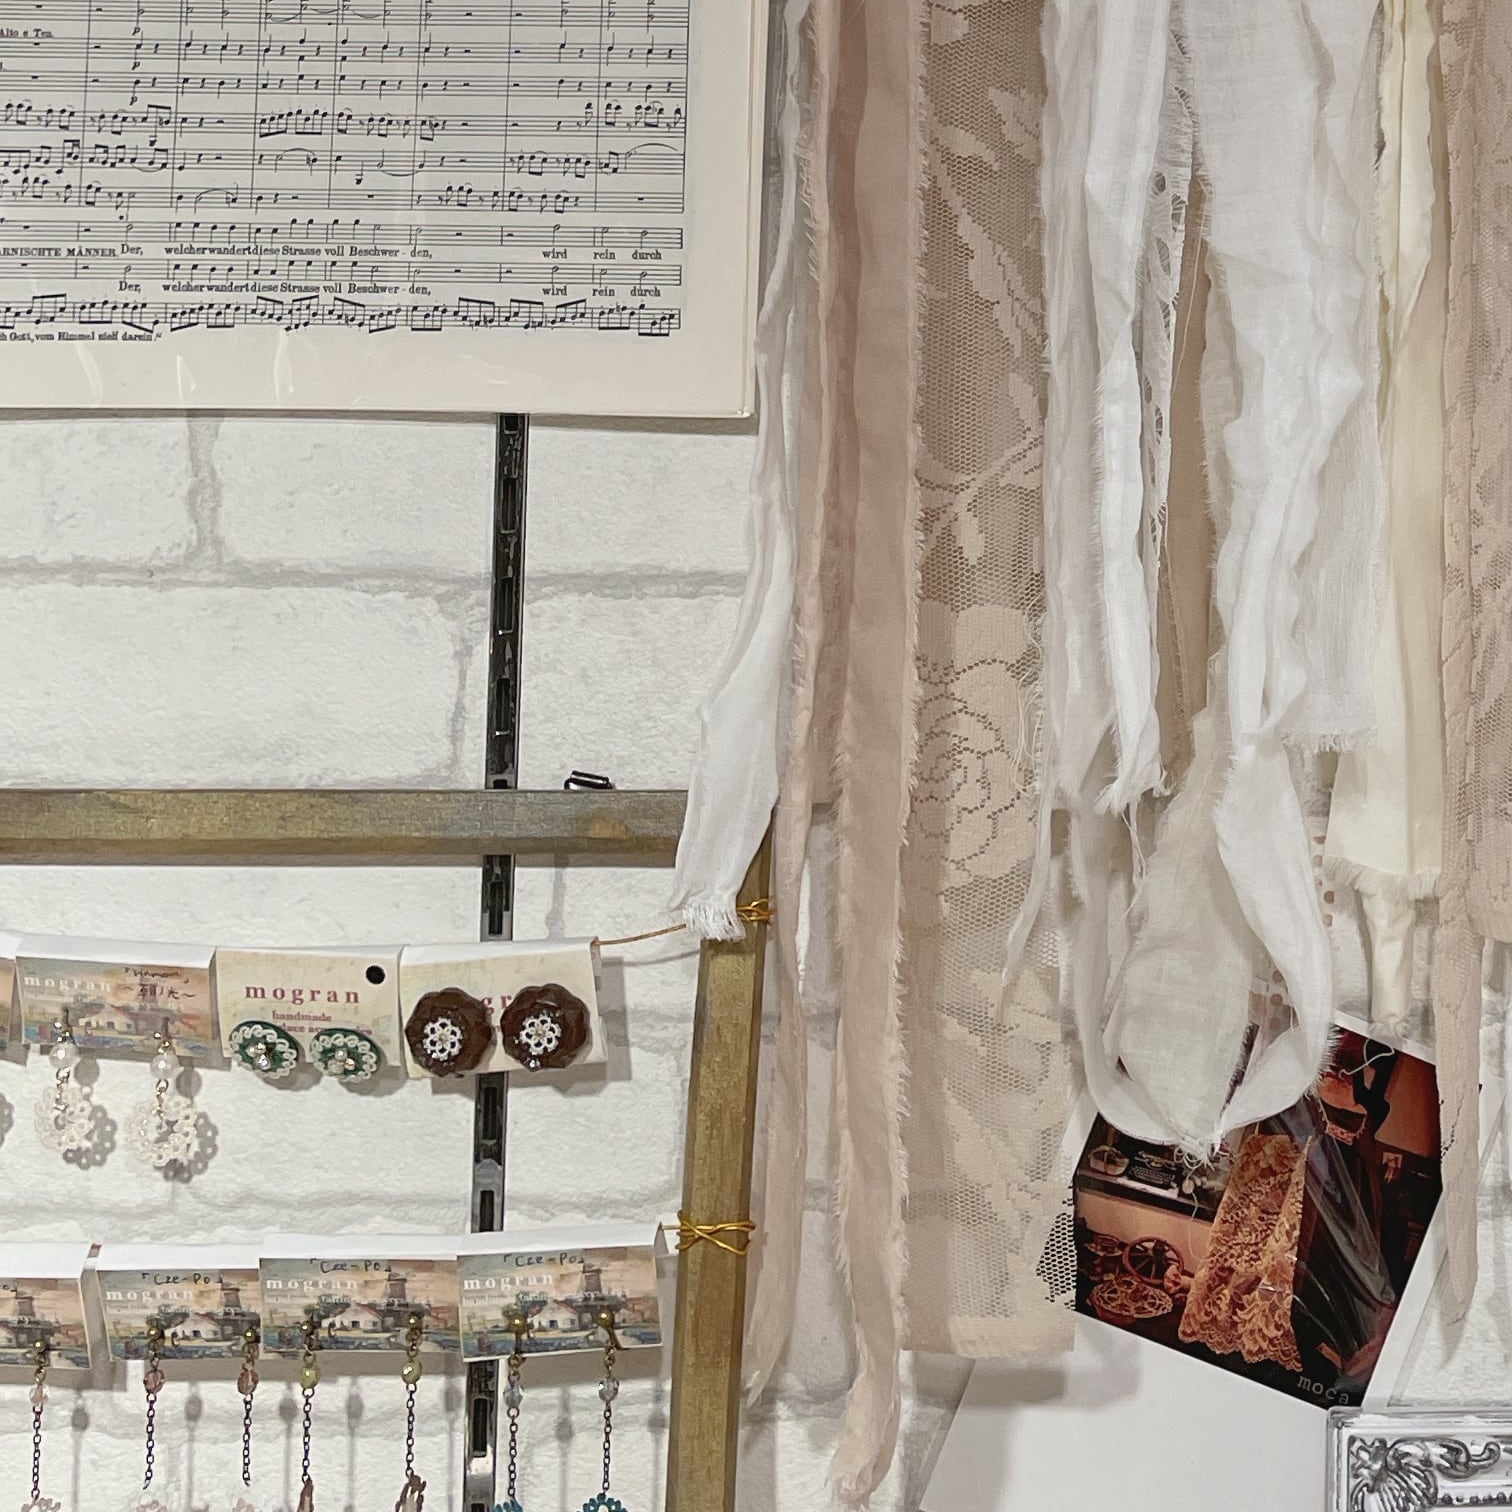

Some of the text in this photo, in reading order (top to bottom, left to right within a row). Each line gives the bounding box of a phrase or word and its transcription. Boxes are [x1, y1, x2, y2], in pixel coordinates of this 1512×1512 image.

[121, 244, 143, 255] Der,
[164, 244, 207, 255] welcher
[208, 245, 251, 255] wandert
[252, 245, 280, 255] diese
[282, 245, 321, 256] Strasse
[325, 246, 344, 256] voll
[543, 248, 567, 259] wird
[593, 249, 616, 259] rein
[632, 249, 662, 260] durch
[119, 281, 141, 293] Der,
[162, 282, 204, 292] welcher
[206, 282, 249, 292] wandert
[250, 283, 278, 292] diese
[281, 282, 320, 293] Strasse
[323, 283, 342, 293] voll
[543, 286, 567, 296] wird
[592, 287, 615, 296] rein
[630, 286, 661, 297] durch
[24, 976, 111, 992] mogran
[245, 986, 359, 1005] mogran
[272, 1010, 332, 1022] handmade
[266, 1279, 357, 1292] mogran
[463, 1273, 553, 1290] mogran
[105, 1290, 193, 1301] mogran
[1297, 1376, 1349, 1404] moca
